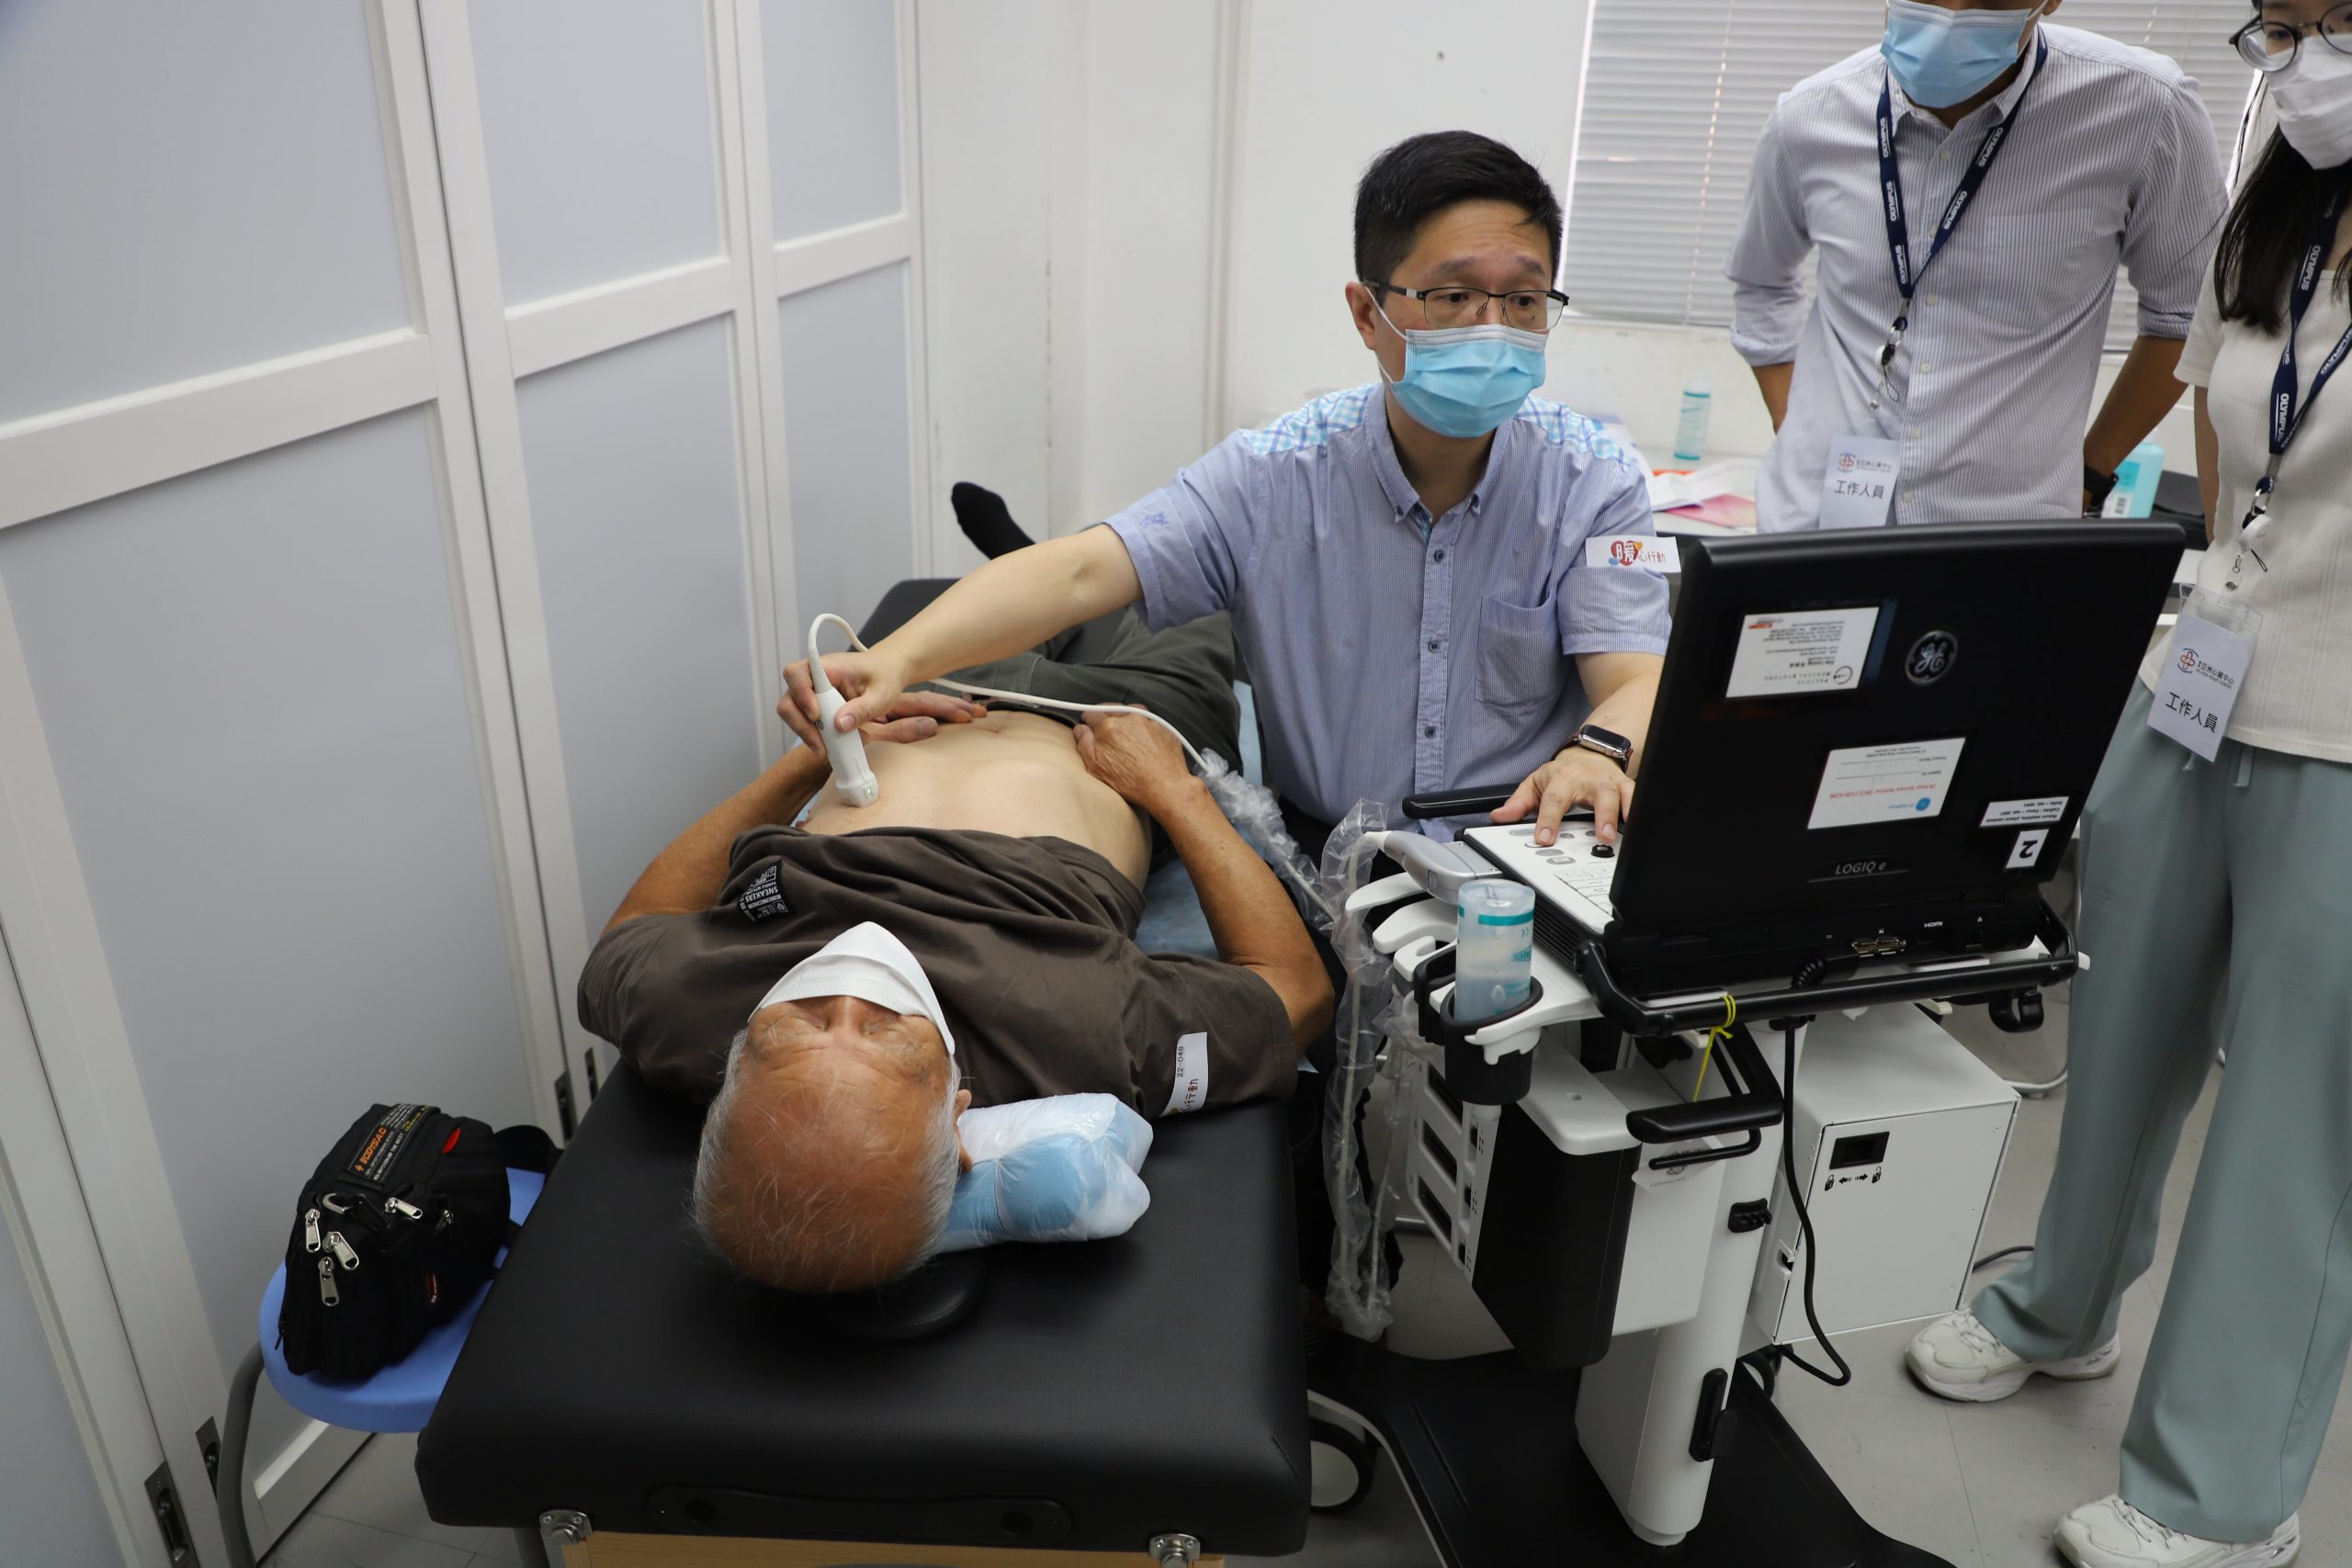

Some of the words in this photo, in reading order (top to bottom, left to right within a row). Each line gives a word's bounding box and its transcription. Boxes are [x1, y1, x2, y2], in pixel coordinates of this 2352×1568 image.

[1880, 118, 1889, 158] OLYMPUS
[1978, 127, 2004, 167] OLYMPUS
[1886, 181, 1896, 221] OLYMPUS
[1944, 190, 1968, 230] OLYMPUS
[1895, 244, 1906, 284] OLYMPUS
[2301, 244, 2321, 291] OLYMPUS
[2278, 393, 2290, 442] OLYMPUS
[1834, 479, 1884, 500] 工作人員
[2165, 692, 2218, 733] 工作人員
[1836, 861, 1876, 875] LOGIQ
[1879, 861, 1887, 871] e
[2018, 840, 2039, 859] 2
[745, 886, 778, 903] SNEAKERS
